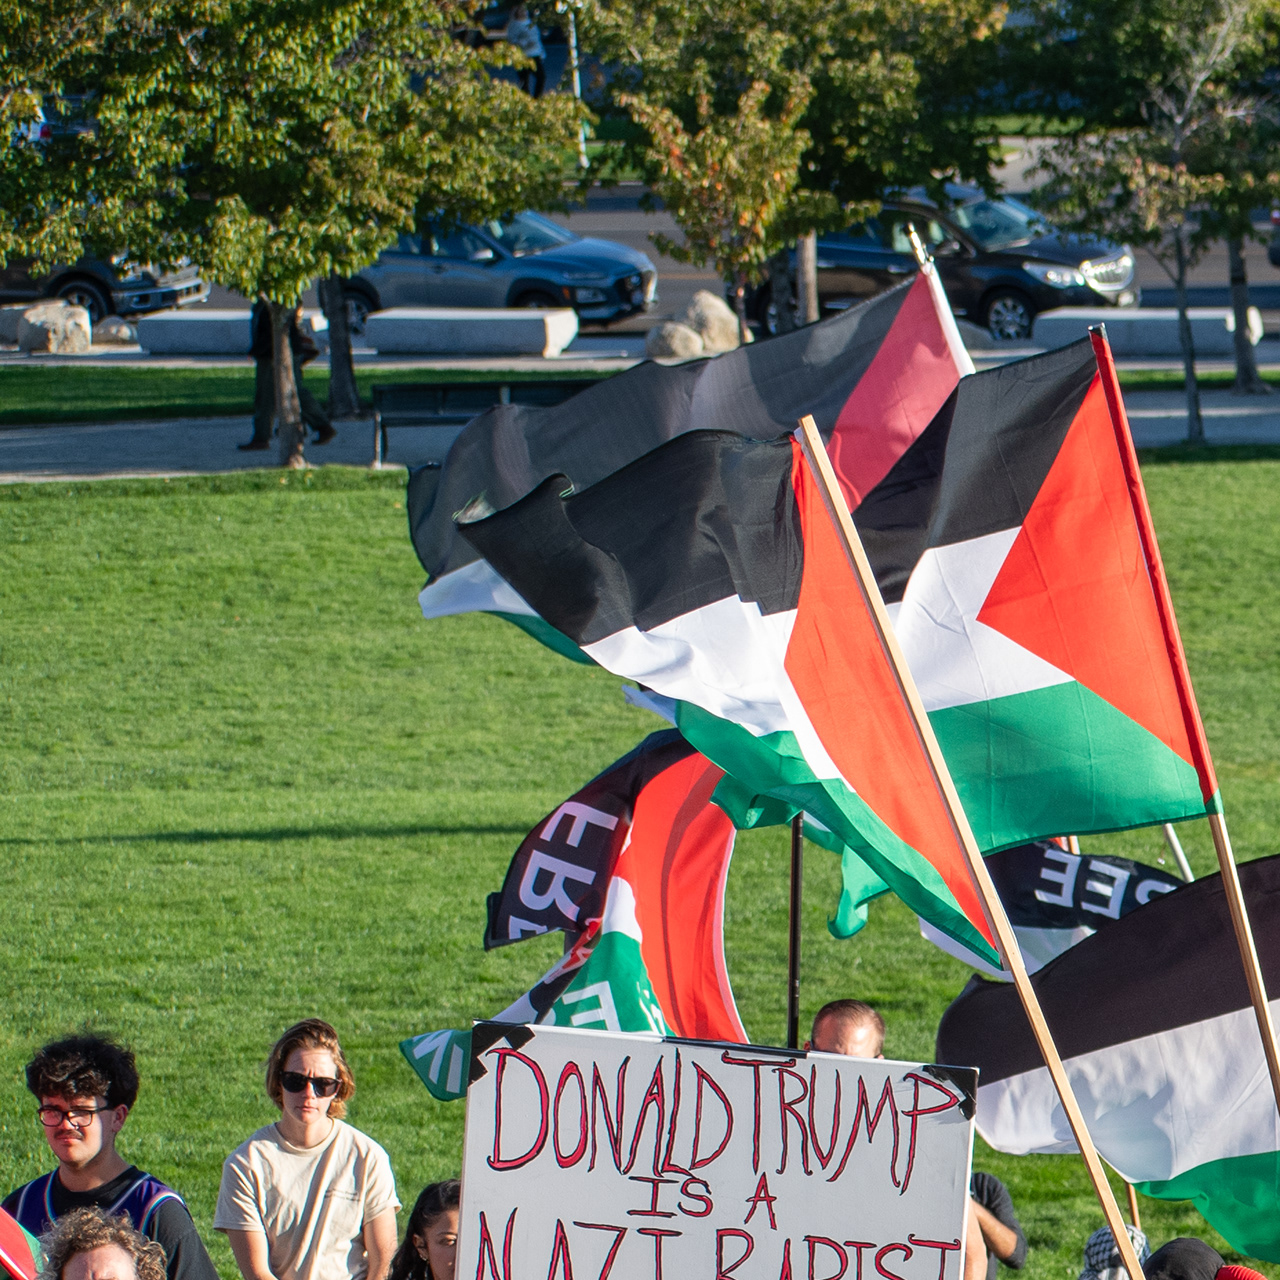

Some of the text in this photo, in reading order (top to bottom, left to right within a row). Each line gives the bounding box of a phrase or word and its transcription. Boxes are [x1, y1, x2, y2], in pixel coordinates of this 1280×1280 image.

[486, 1046, 734, 1178] DONALD
[720, 1049, 960, 1196] TRUMP
[626, 1171, 779, 1230] IS A
